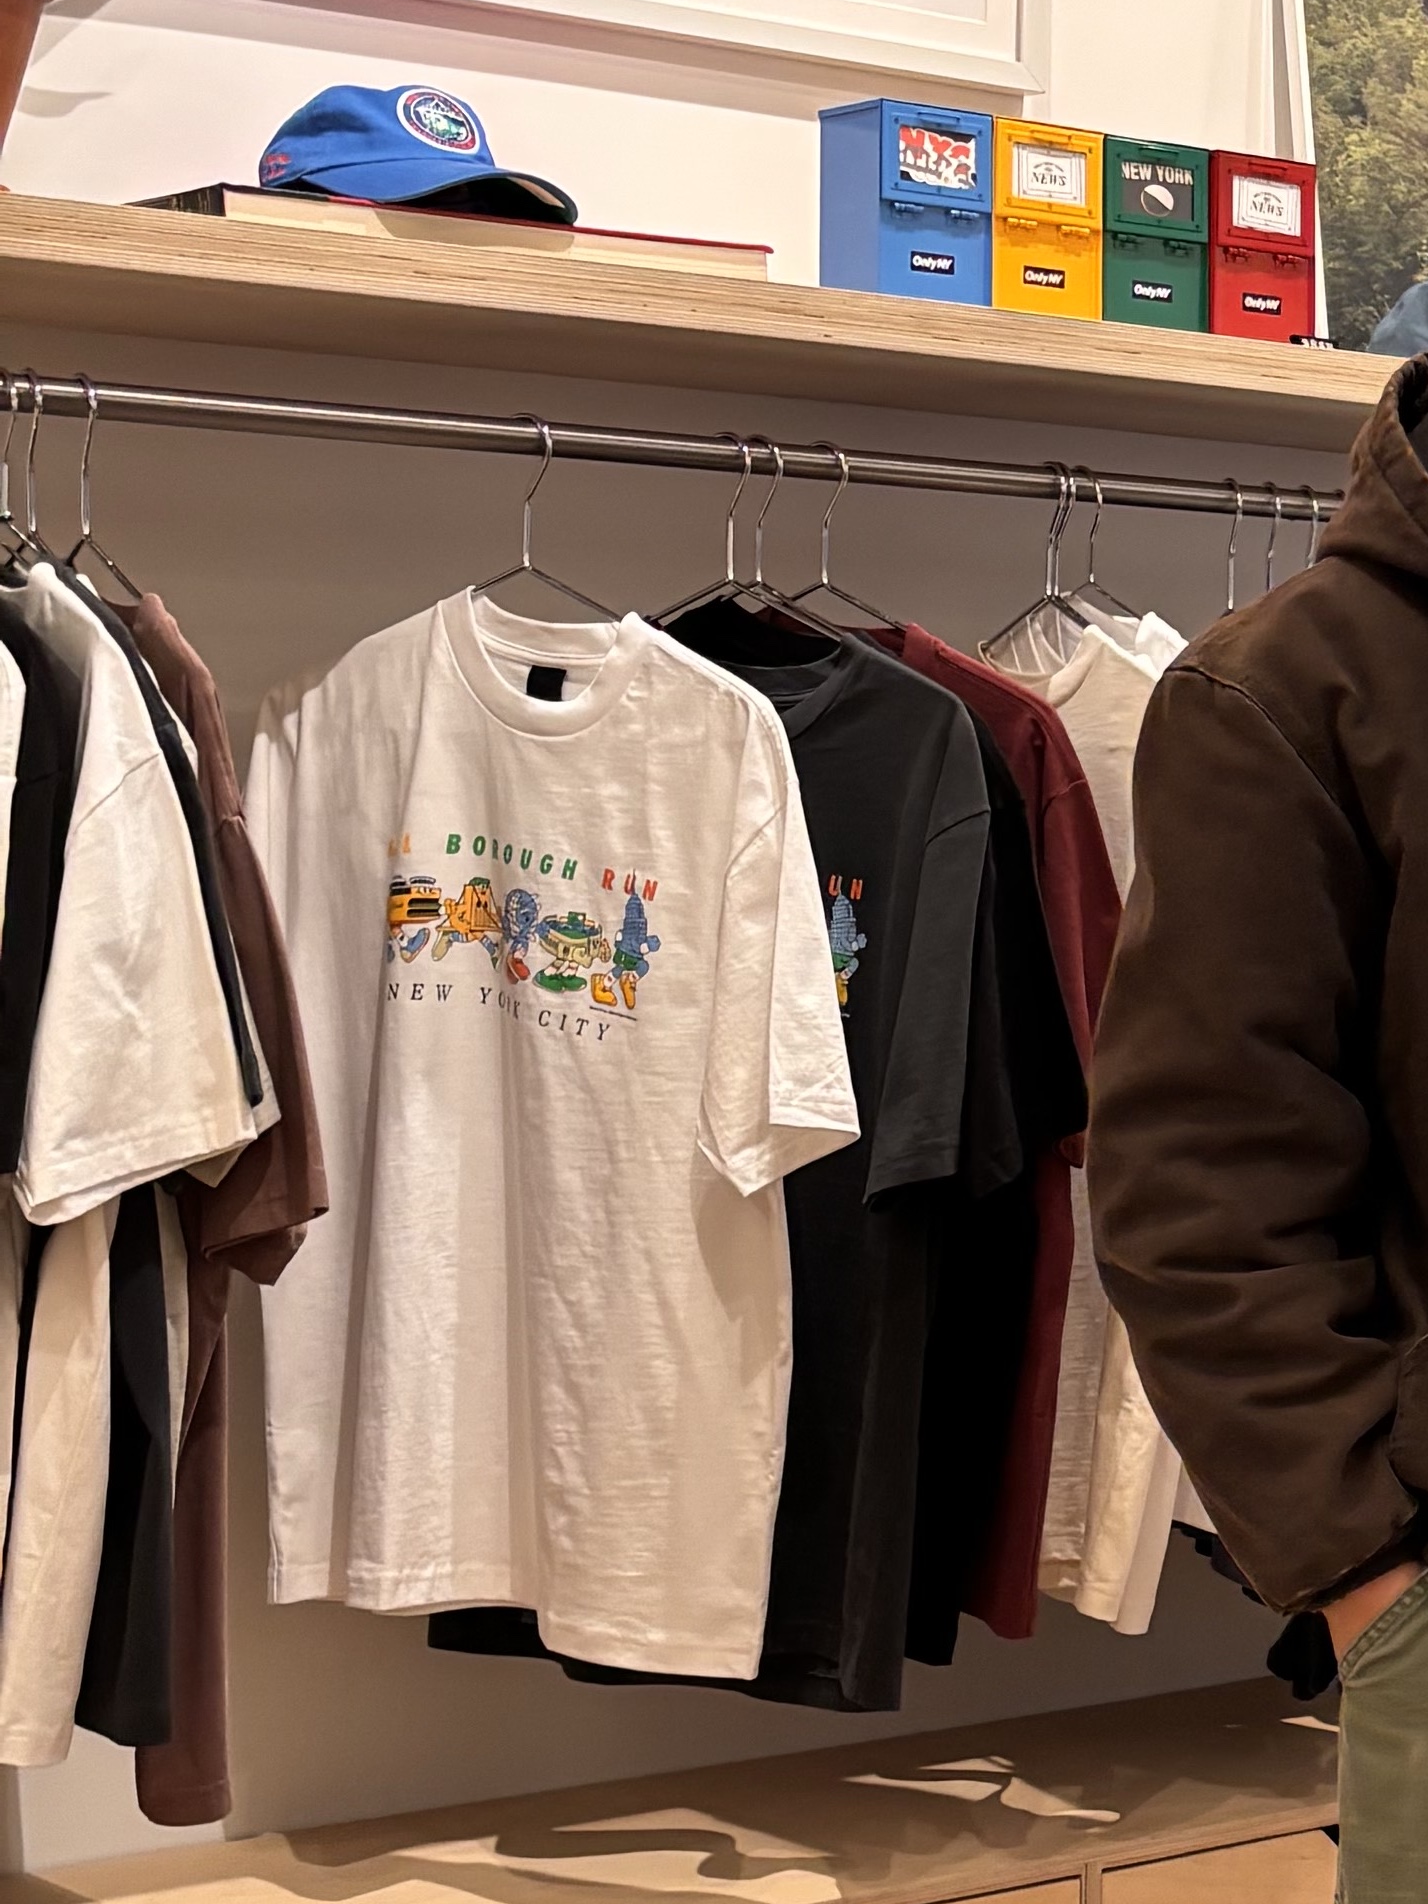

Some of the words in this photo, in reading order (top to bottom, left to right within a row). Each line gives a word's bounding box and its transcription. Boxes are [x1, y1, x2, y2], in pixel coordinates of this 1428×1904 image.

[1031, 172, 1067, 187] NEWS
[1121, 162, 1153, 181] NEW
[1155, 166, 1193, 186] YORK
[1250, 200, 1284, 217] NEWS
[445, 833, 578, 880] BOROUGH
[601, 868, 658, 901] RUN
[828, 874, 863, 900] UN
[387, 983, 453, 1002] NEW
[538, 1009, 611, 1041] CITY
